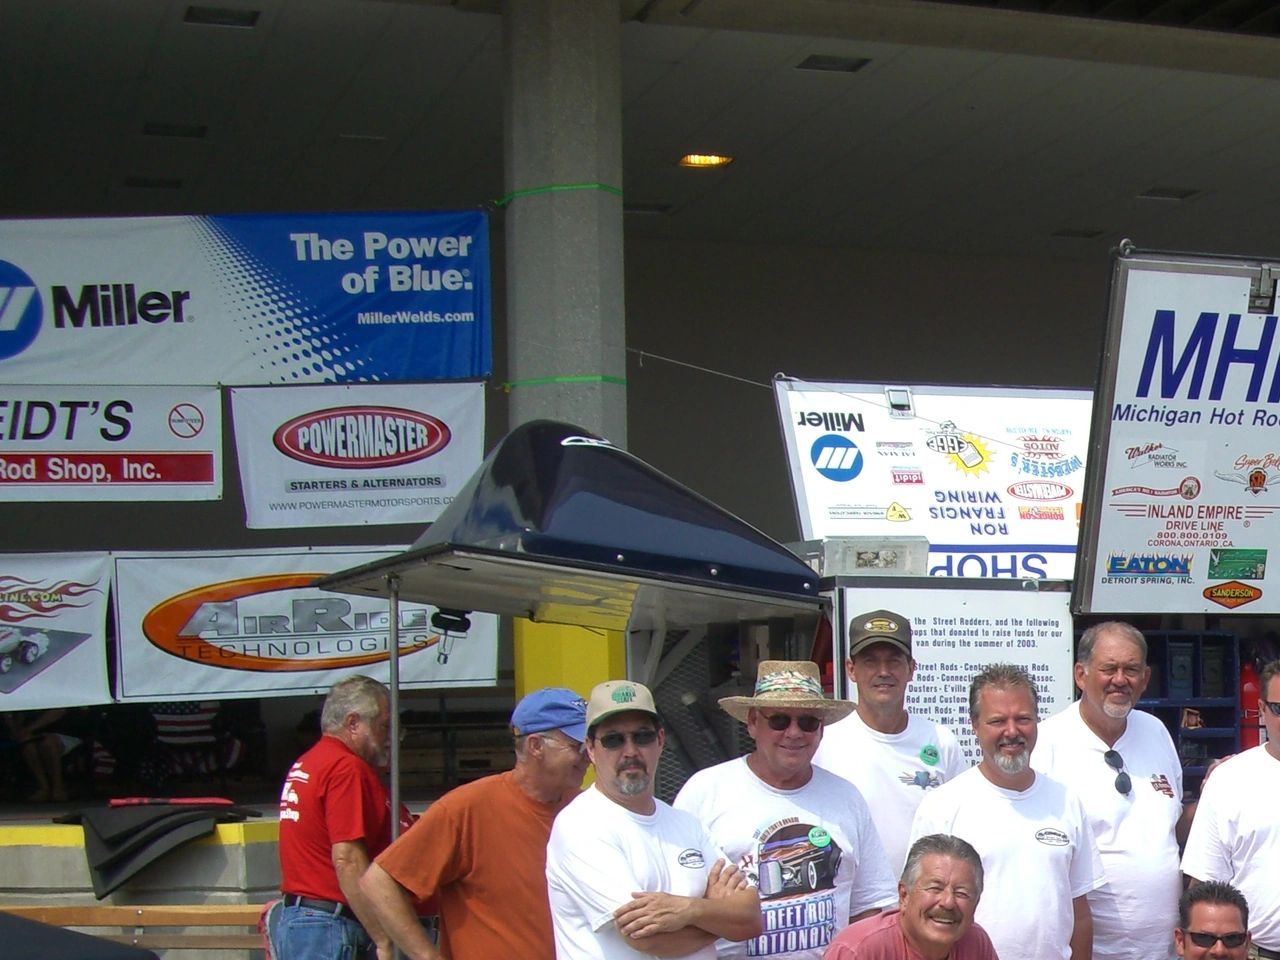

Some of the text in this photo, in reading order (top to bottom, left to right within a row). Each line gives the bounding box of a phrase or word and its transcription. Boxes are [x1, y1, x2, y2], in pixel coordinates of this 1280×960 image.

[290, 232, 472, 261] The Power
[342, 266, 381, 294] of
[51, 284, 191, 328] Miller
[357, 311, 475, 325] MillerWelds.com
[797, 411, 866, 432] Miller
[1112, 404, 1201, 428] Michigan
[1209, 407, 1244, 426] Hot
[298, 416, 429, 458] POWERMASTER
[1024, 441, 1059, 451] AUTOS
[0, 457, 161, 482] Rod Shop, Inc.
[290, 477, 441, 491] STARTERS & ALTERNATORS
[269, 496, 457, 511] WWW.POWERMASTERMOTORSPORTS.CO
[934, 491, 1002, 504] WIRING
[930, 506, 1005, 520] FRANCIS
[1147, 504, 1243, 520] INLAND EMPIRE
[971, 522, 1009, 536] RON
[1165, 521, 1224, 531] DRIVE LINE
[1110, 556, 1190, 571] EATON
[1140, 577, 1175, 585] SPRING,
[914, 618, 927, 626] the
[933, 618, 957, 626] Street
[960, 618, 992, 627] Rodders,
[1011, 618, 1023, 626] the
[1026, 618, 1060, 628] following
[930, 629, 946, 637] that
[949, 629, 979, 637] donated
[982, 629, 990, 637] to
[992, 629, 1011, 637] raise
[916, 639, 930, 647] van
[933, 639, 956, 649] during
[1016, 640, 1038, 648] 2003.
[914, 663, 937, 671] Street
[940, 663, 958, 671] Rods
[1032, 663, 1049, 671] Rods
[917, 674, 935, 682] Rods
[1032, 674, 1056, 682] Assoc.
[908, 685, 938, 693] Dusters
[944, 685, 966, 693] E'ville
[906, 695, 1055, 704] Rod and Custom Rods
[908, 706, 931, 714] Street
[762, 898, 834, 931] REET ROD
[746, 922, 834, 956] NATIONALS
